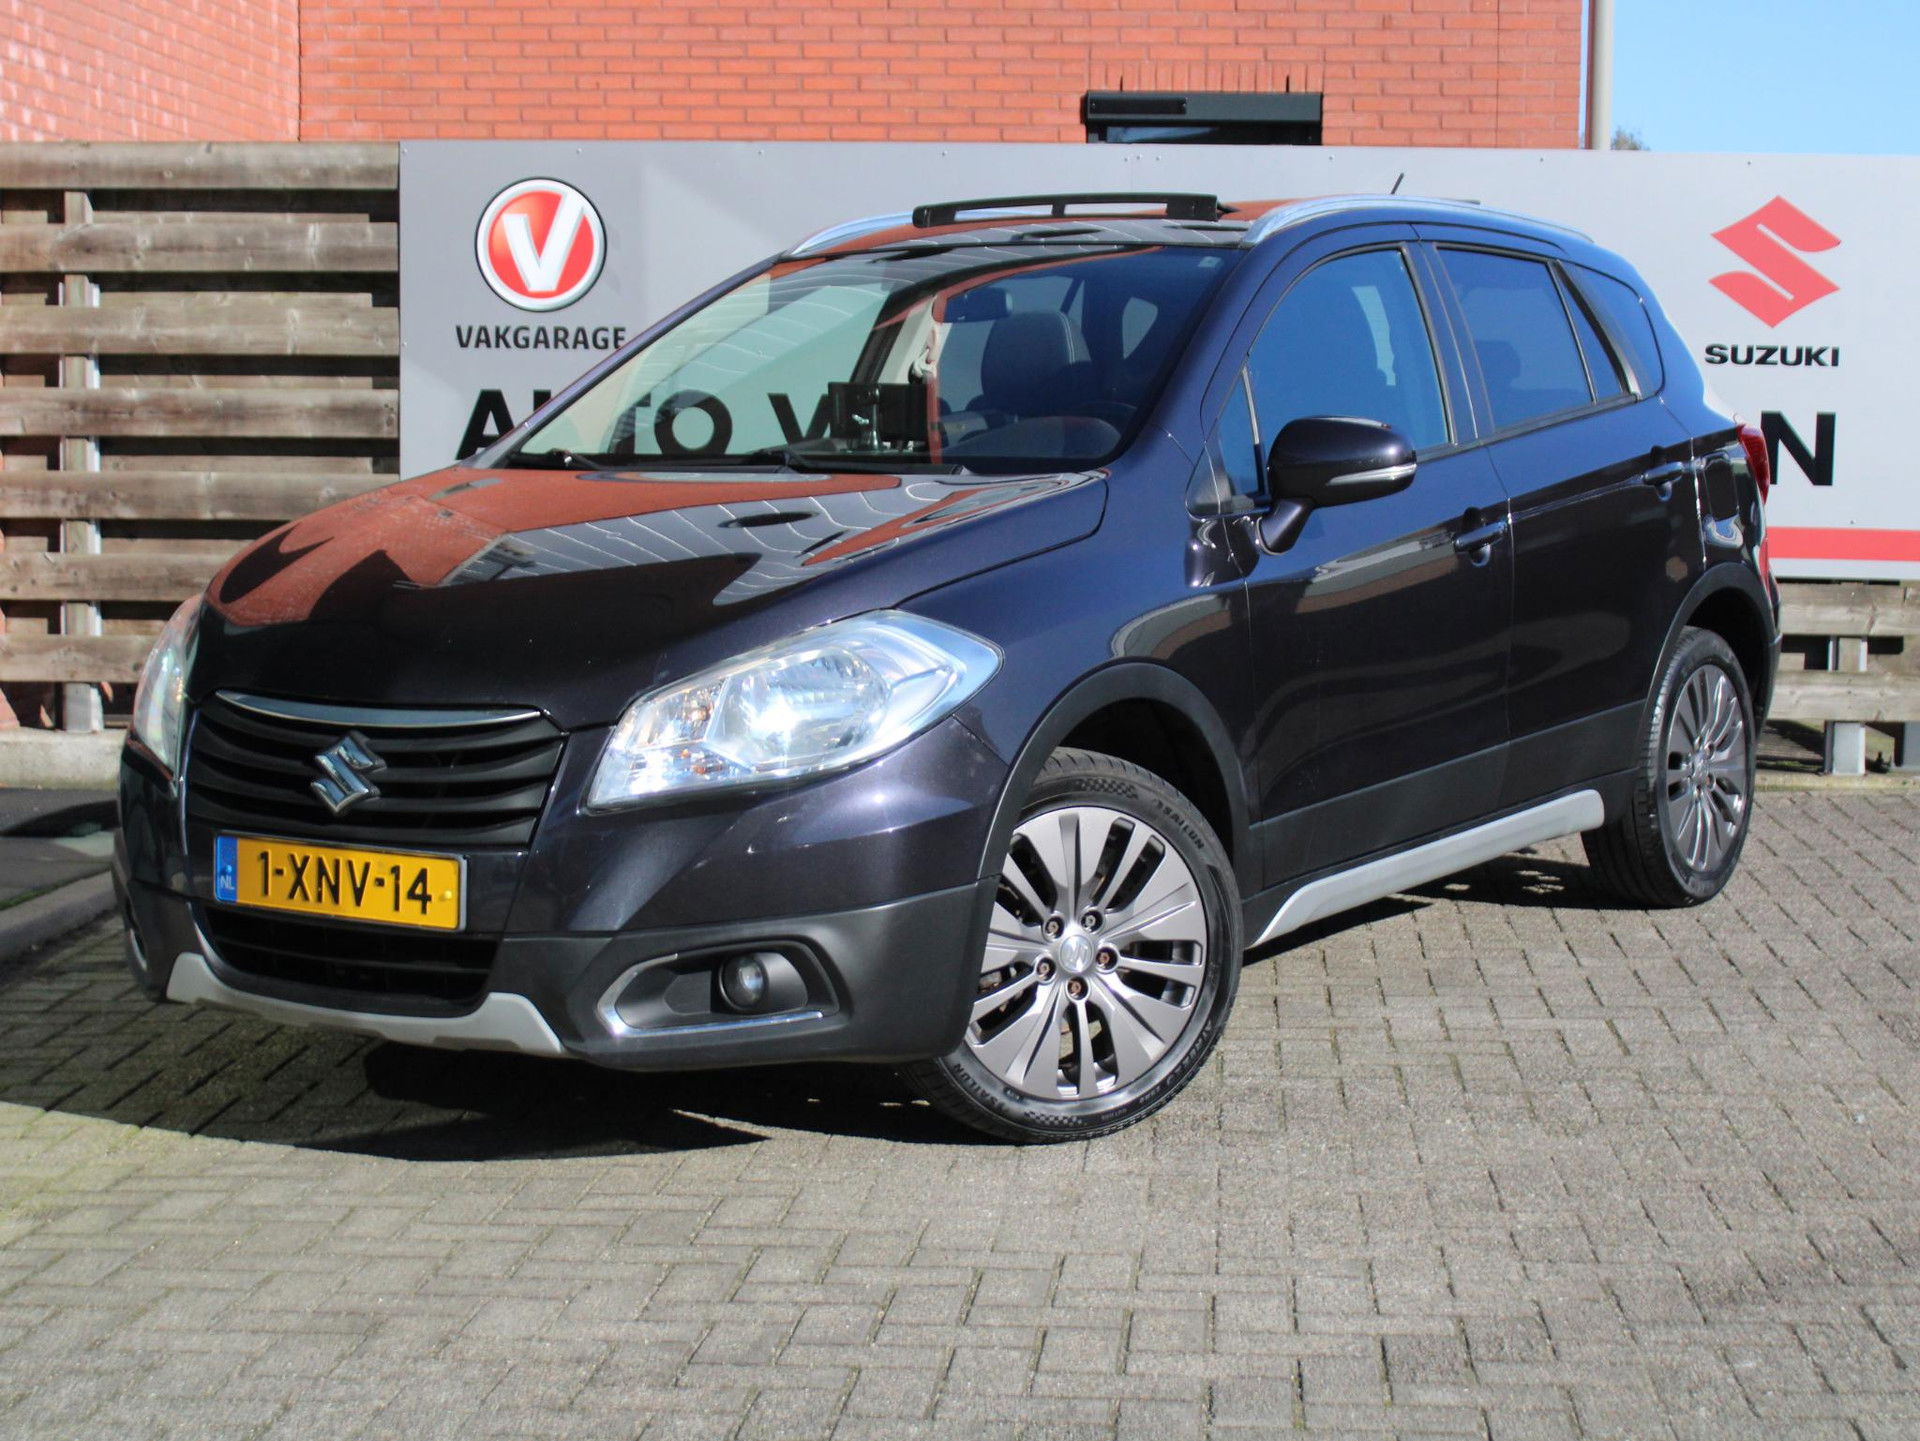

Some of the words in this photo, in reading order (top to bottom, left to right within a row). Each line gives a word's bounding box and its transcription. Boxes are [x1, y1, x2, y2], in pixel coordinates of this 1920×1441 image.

[455, 325, 627, 350] VAKGARAGE
[1704, 343, 1840, 367] SUZUKI
[455, 389, 733, 460] ATO
[219, 874, 236, 891] NL
[259, 850, 433, 915] 1-XNV-14
